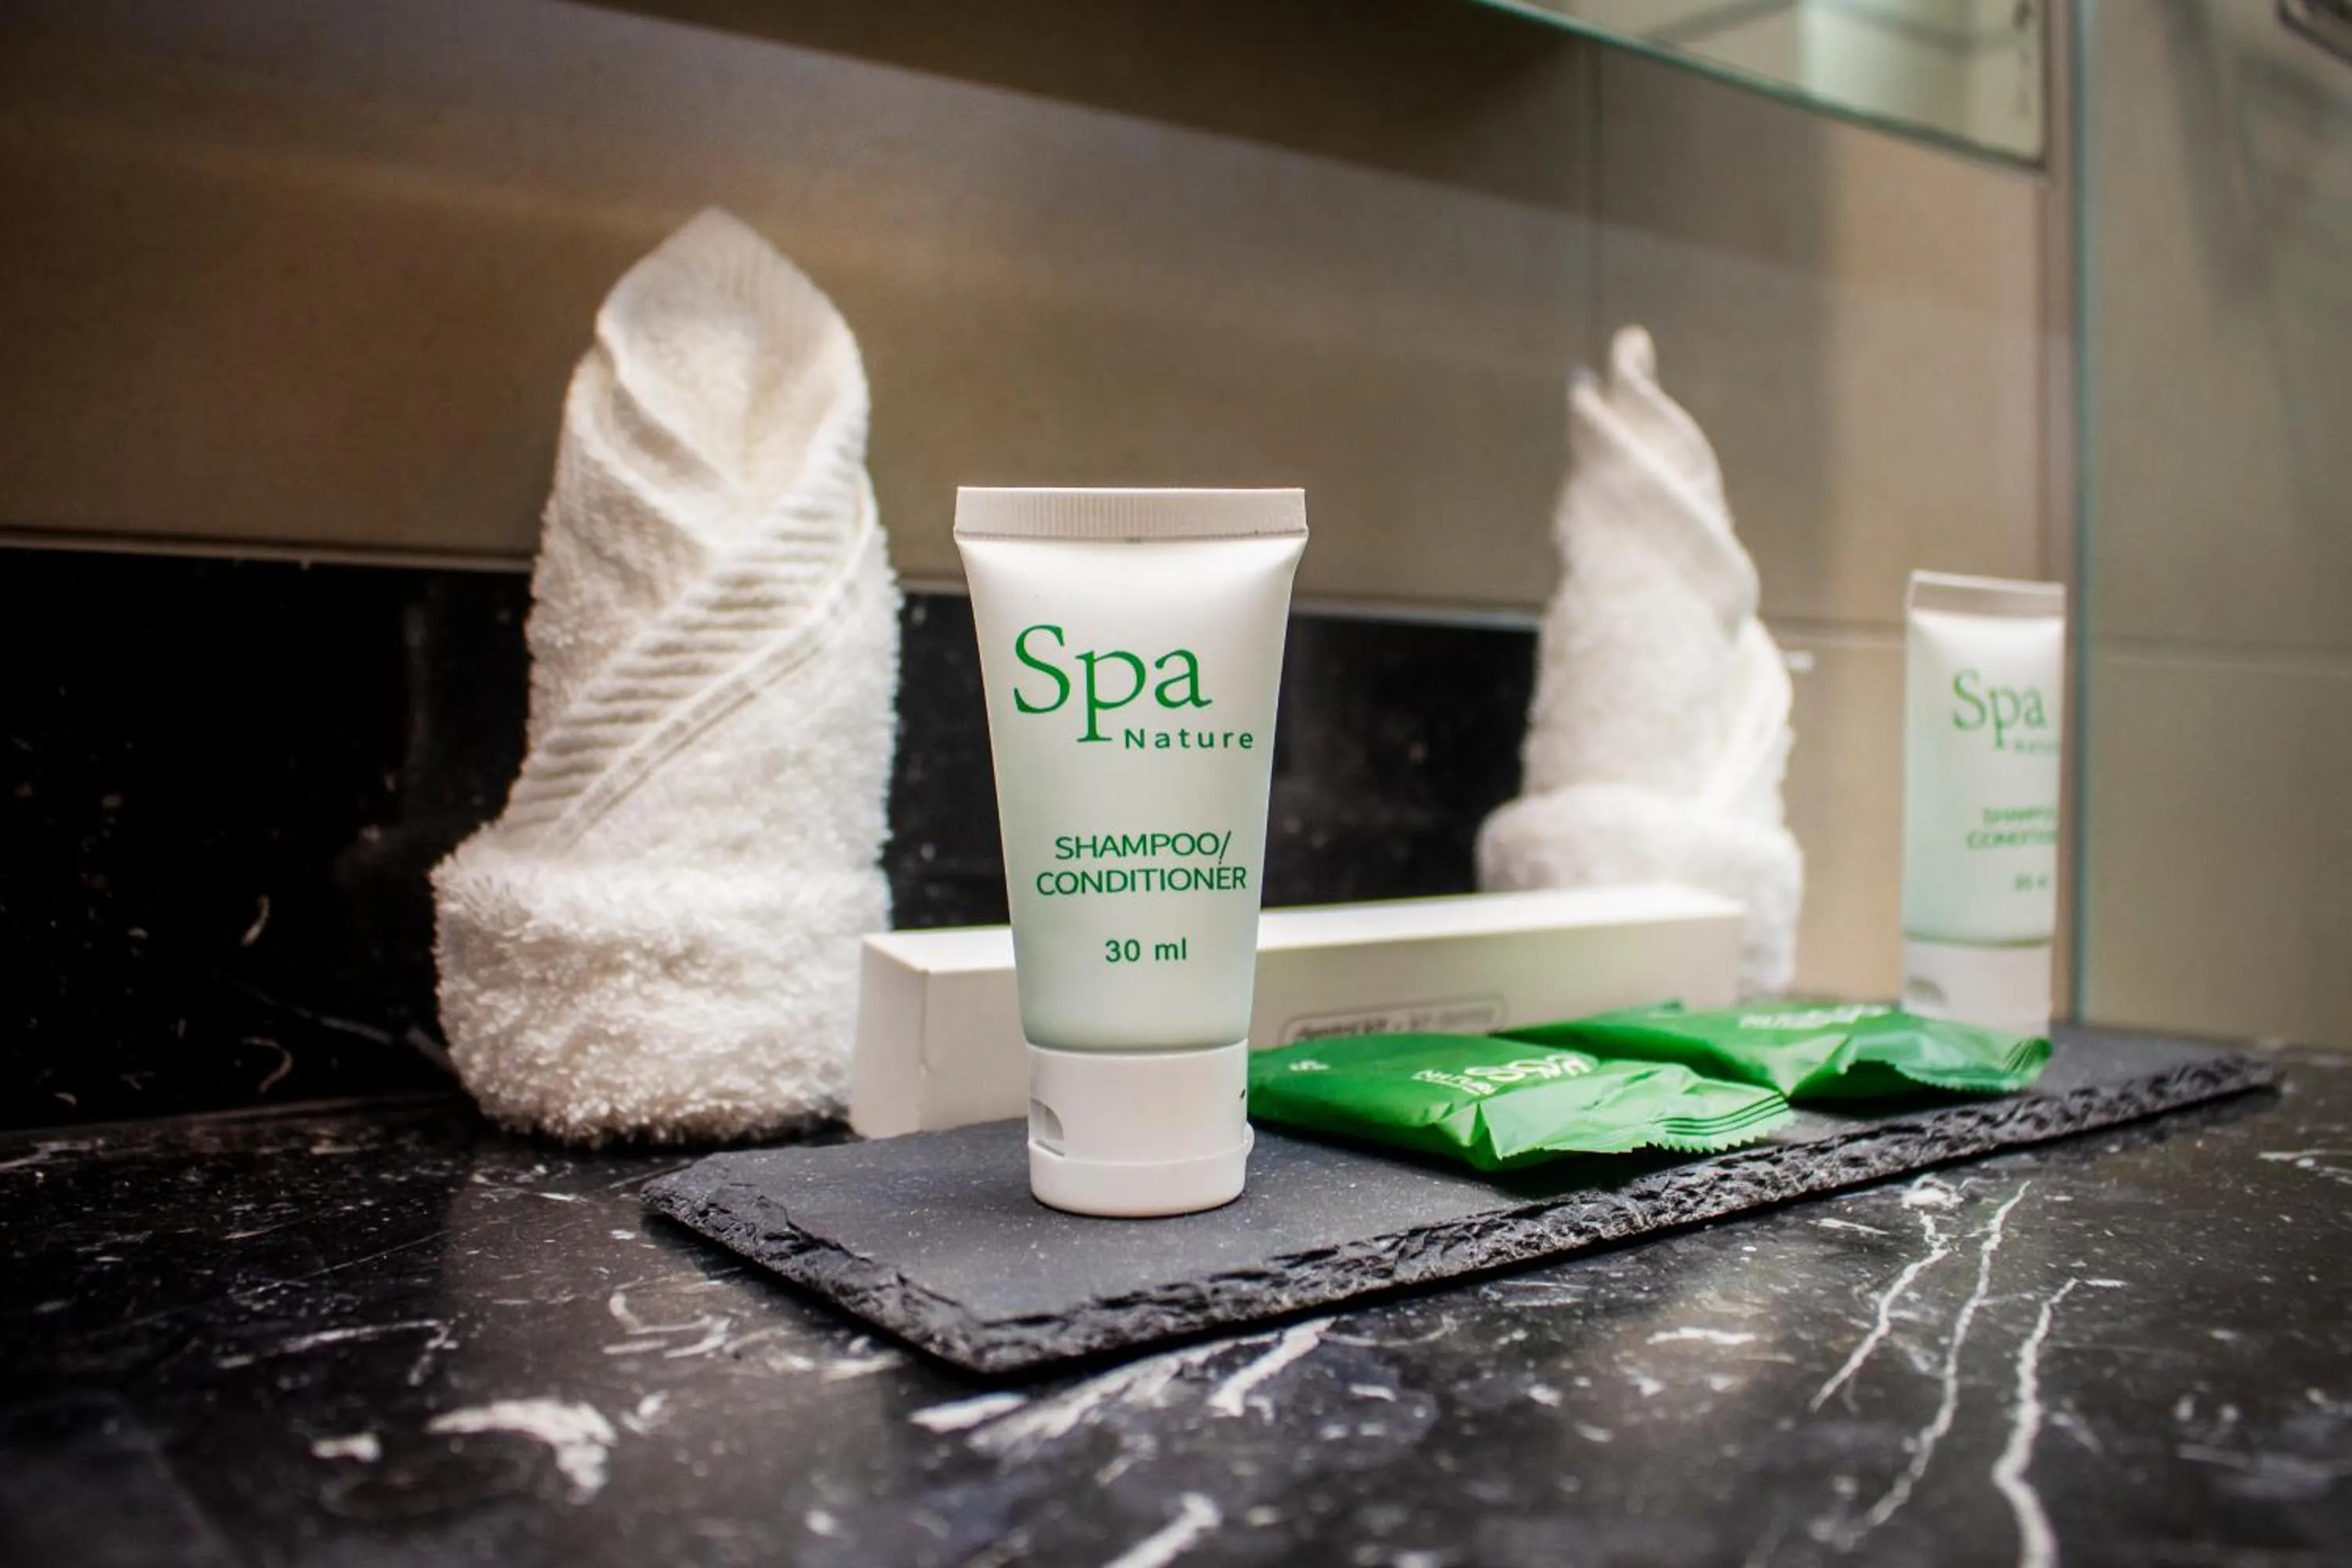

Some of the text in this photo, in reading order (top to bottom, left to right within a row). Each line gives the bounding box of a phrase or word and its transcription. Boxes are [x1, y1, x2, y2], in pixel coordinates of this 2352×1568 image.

[1014, 624, 1213, 743] Spa
[1953, 669, 2047, 751] Spa
[1124, 728, 1254, 750] Nature
[1054, 831, 1232, 865] SHAMPOO/
[1036, 866, 1247, 896] CONDITIONER
[1105, 938, 1188, 963] 30 ml
